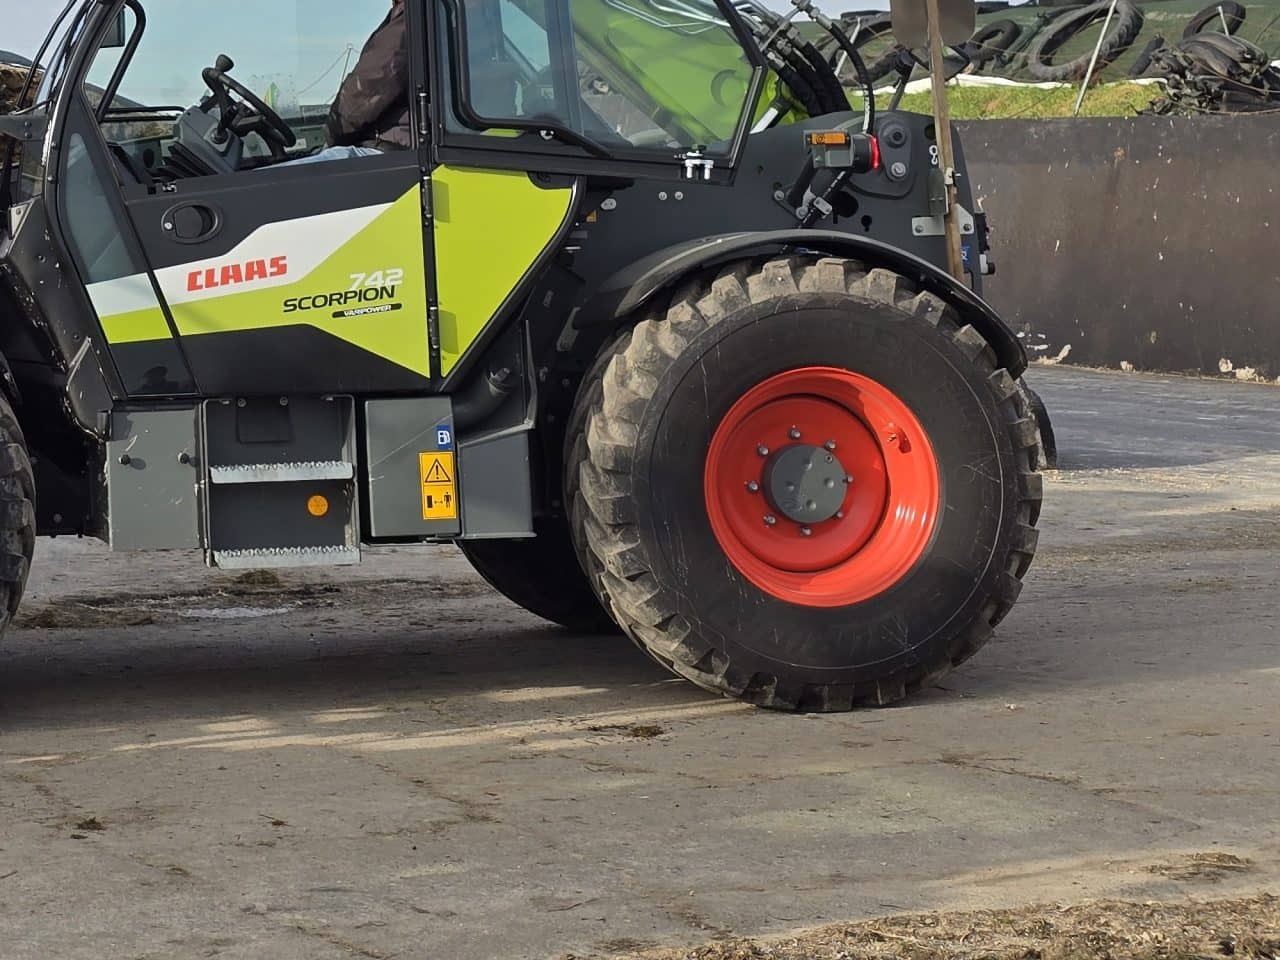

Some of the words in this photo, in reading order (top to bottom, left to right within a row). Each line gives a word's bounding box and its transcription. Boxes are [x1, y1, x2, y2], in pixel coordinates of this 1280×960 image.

[187, 255, 288, 291] CLAAS
[349, 267, 403, 290] 742
[283, 285, 395, 313] SCORPION
